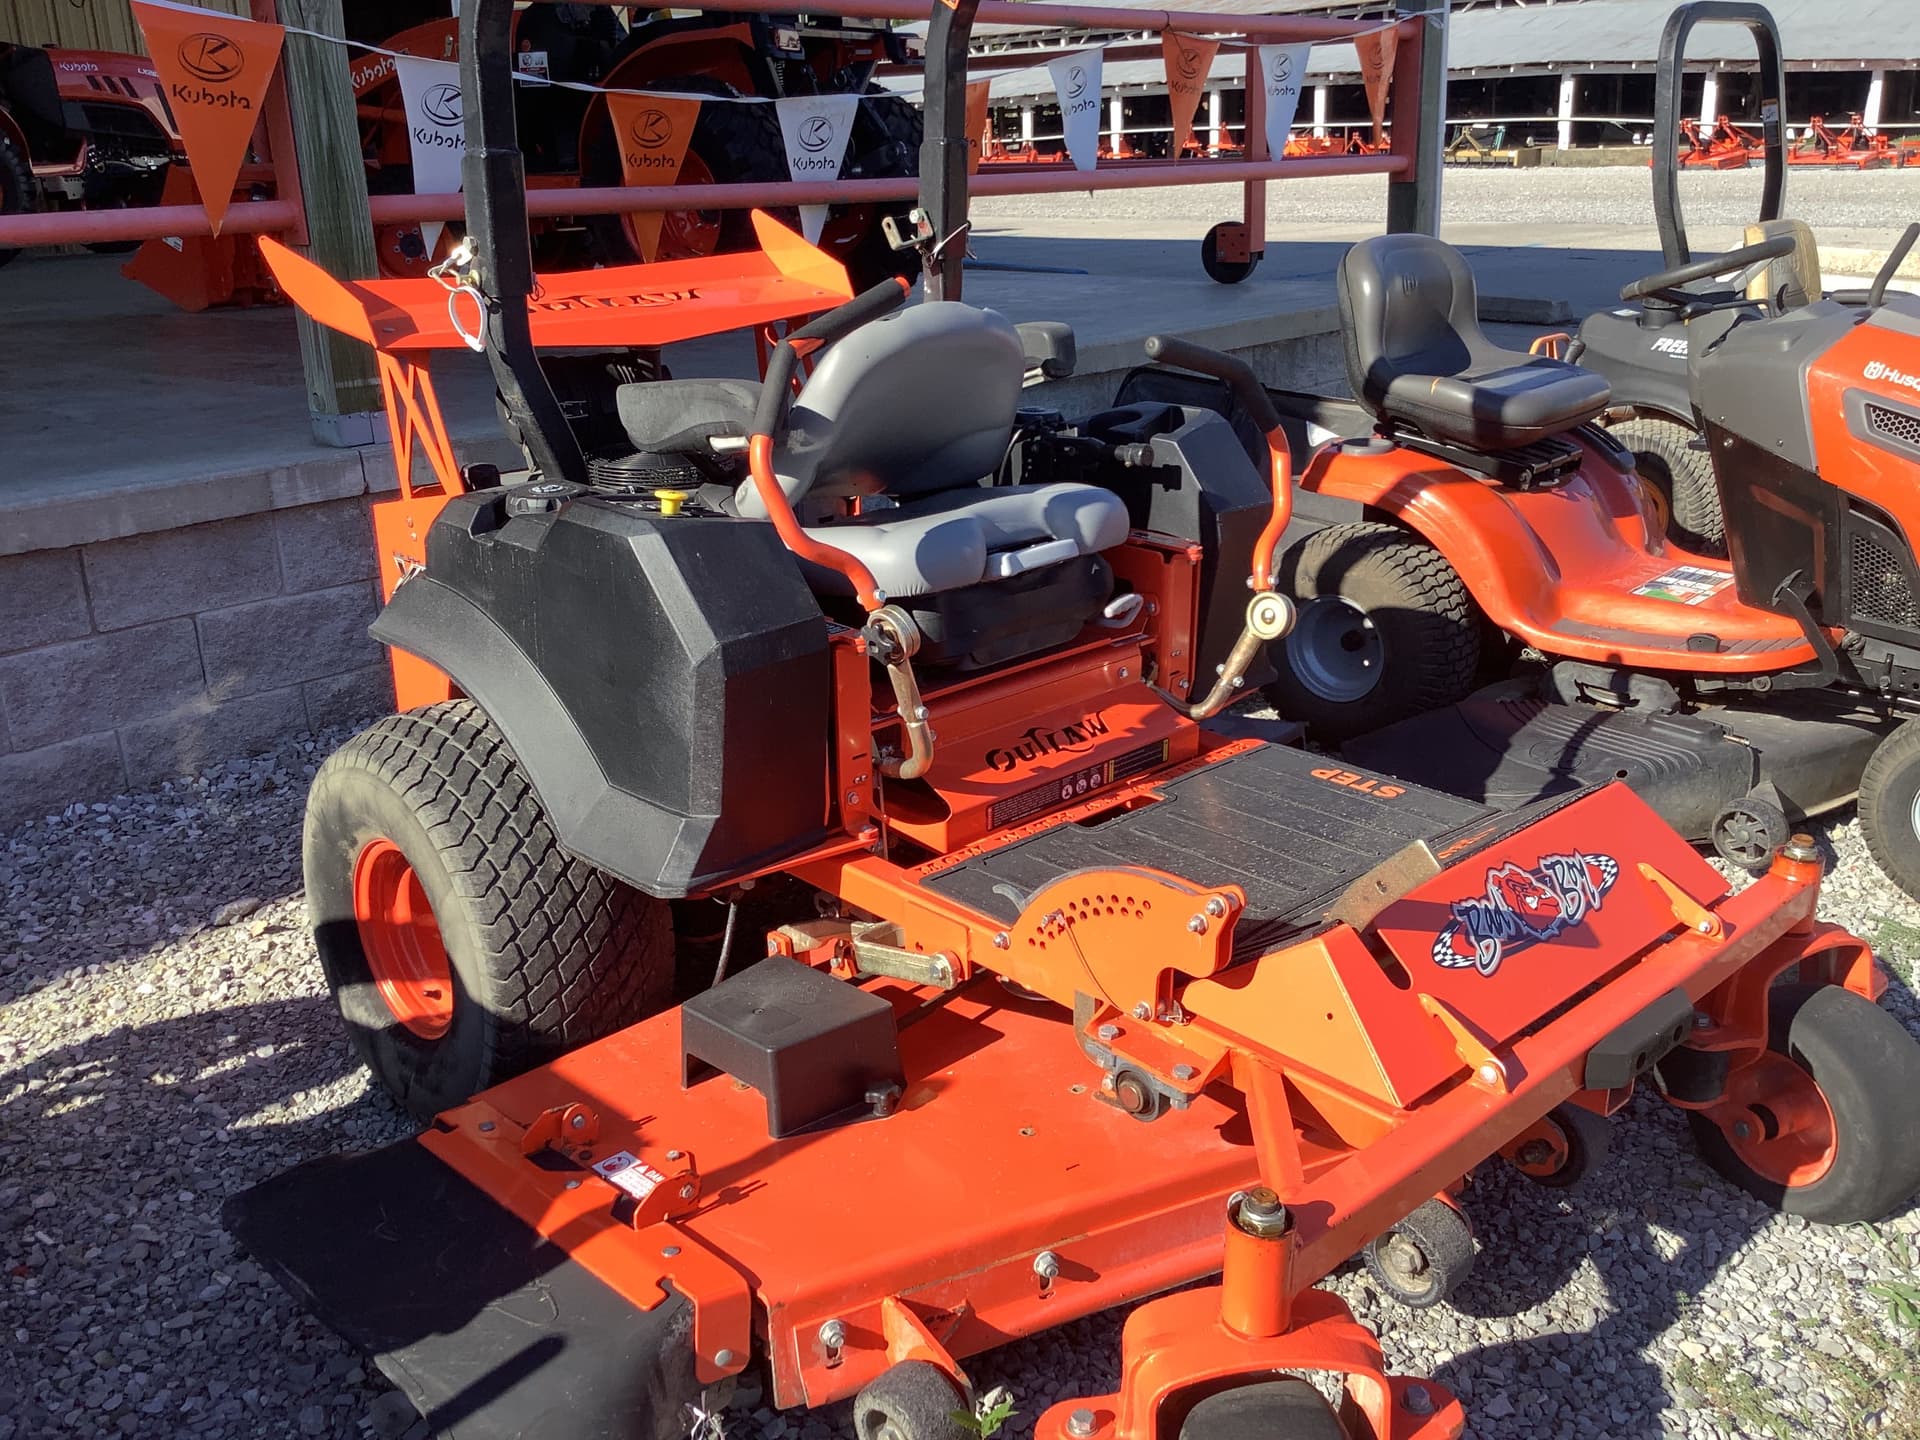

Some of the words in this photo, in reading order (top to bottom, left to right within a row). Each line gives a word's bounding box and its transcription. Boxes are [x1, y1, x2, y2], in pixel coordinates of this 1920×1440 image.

[59, 62, 99, 72] Kubota
[351, 57, 396, 89] Kubota
[172, 83, 252, 110] Kubota
[626, 153, 675, 169] Kubota
[793, 156, 836, 170] Kubota
[1650, 337, 1688, 354] FREE
[1311, 768, 1406, 800] STEP
